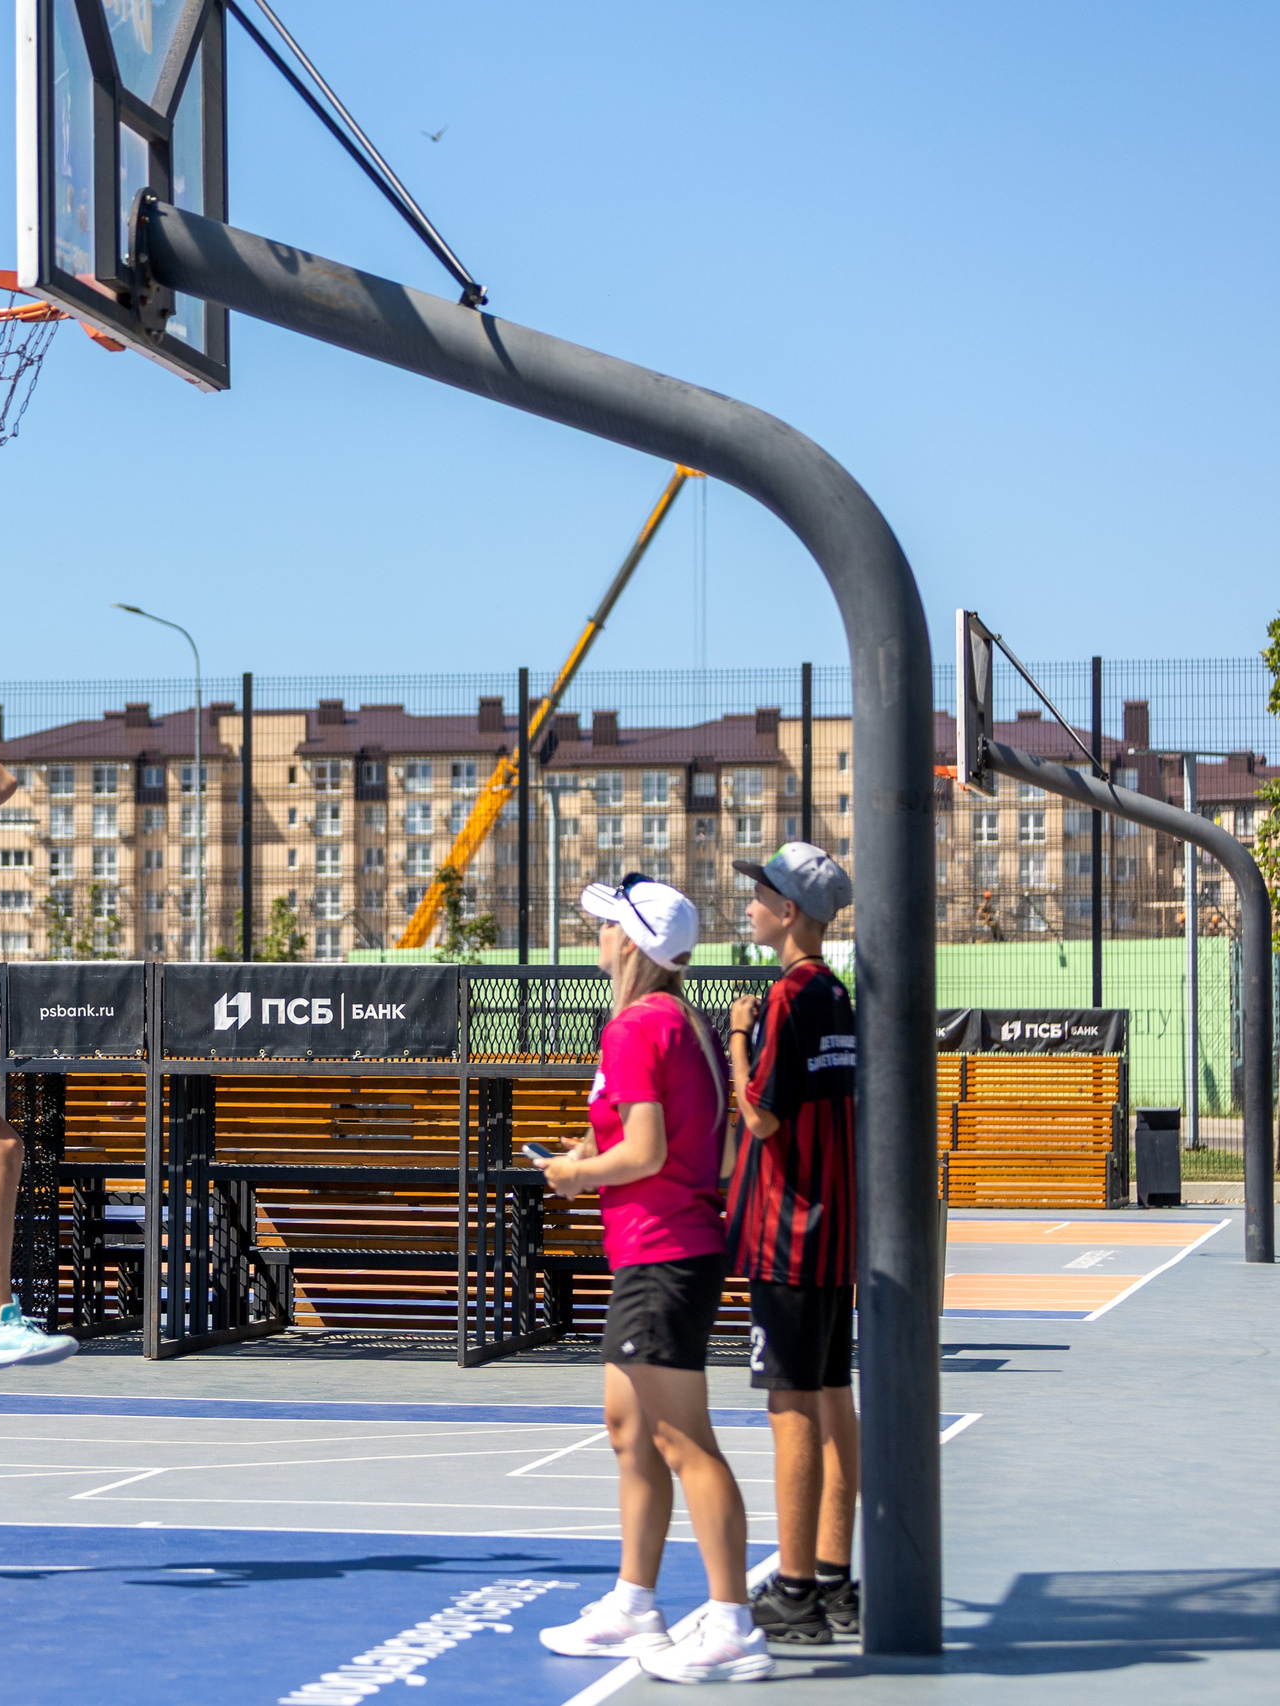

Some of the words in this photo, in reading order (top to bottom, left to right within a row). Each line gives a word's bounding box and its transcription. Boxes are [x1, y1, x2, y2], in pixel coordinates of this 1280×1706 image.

[40, 1004, 115, 1021] psbank.ru
[261, 997, 333, 1026] ПСБ
[352, 1003, 406, 1020] БАНК
[1025, 1023, 1062, 1039] ПСБ
[1070, 1025, 1099, 1036] БАНК
